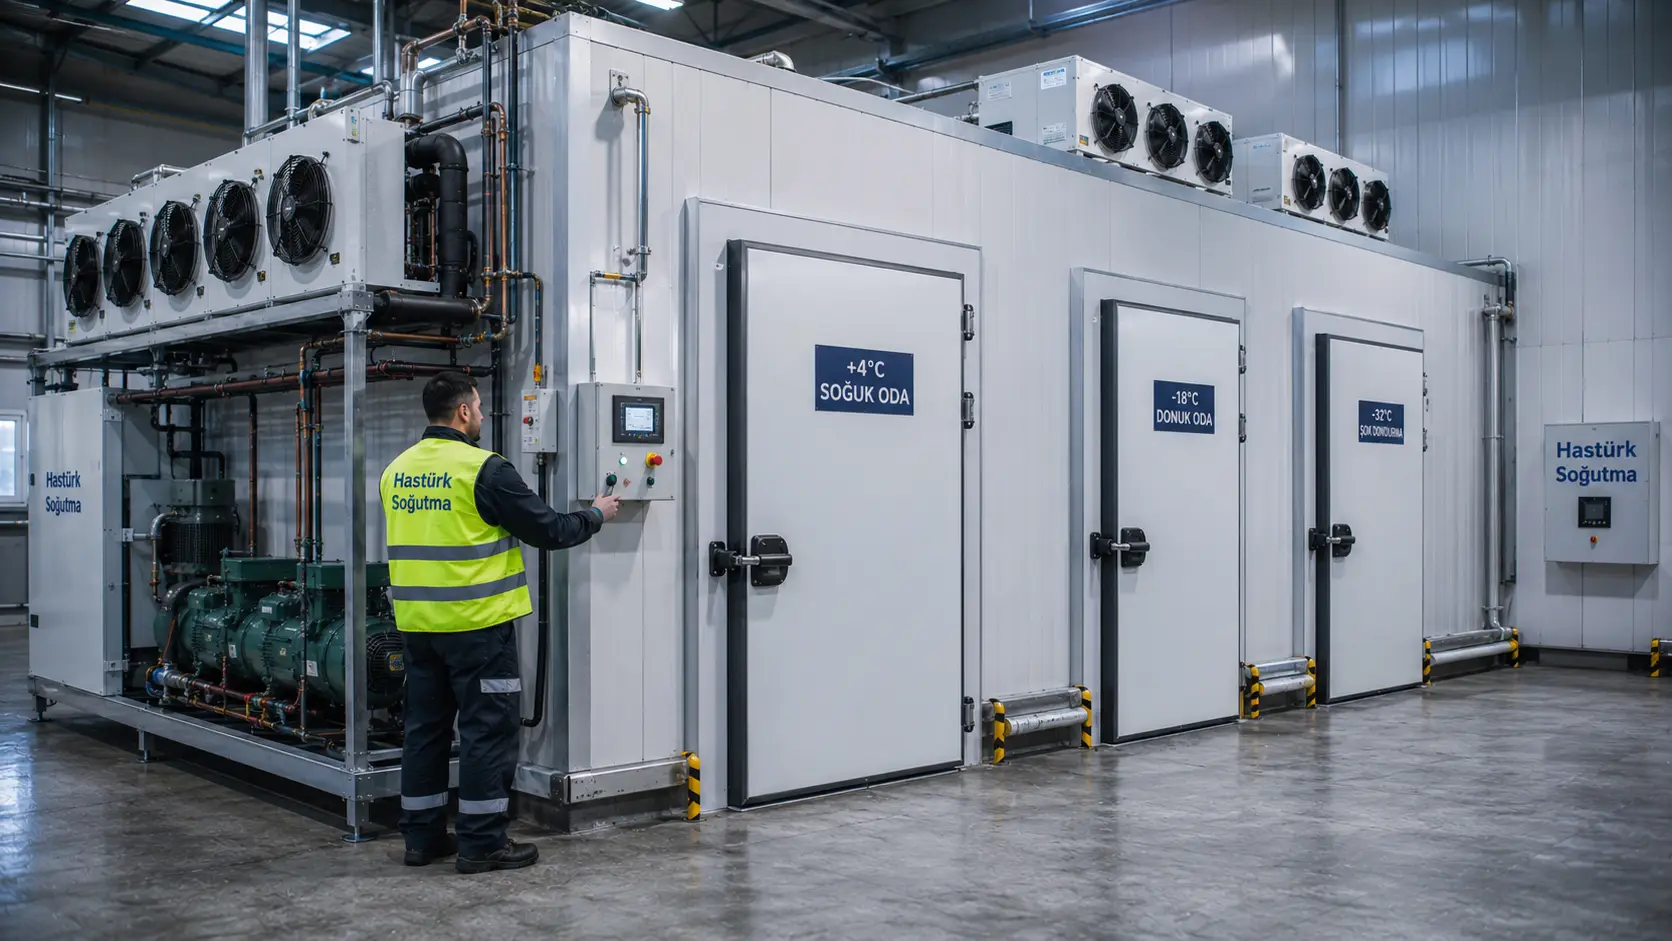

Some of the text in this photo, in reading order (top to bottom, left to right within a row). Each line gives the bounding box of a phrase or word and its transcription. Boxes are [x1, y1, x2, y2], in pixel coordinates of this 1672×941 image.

[847, 359, 885, 378] +4°C
[820, 380, 910, 405] SOĞUK ODA
[1171, 391, 1199, 406] -18°C
[1156, 409, 1213, 426] DONUK ODA
[1371, 408, 1392, 422] -32°C
[1556, 440, 1637, 458] Hastürk
[46, 470, 81, 488] Hastürk
[393, 472, 453, 488] Hastürk
[1556, 465, 1637, 487] Soğutma
[45, 496, 82, 516] Soğutma
[391, 494, 452, 514] Soğutma
